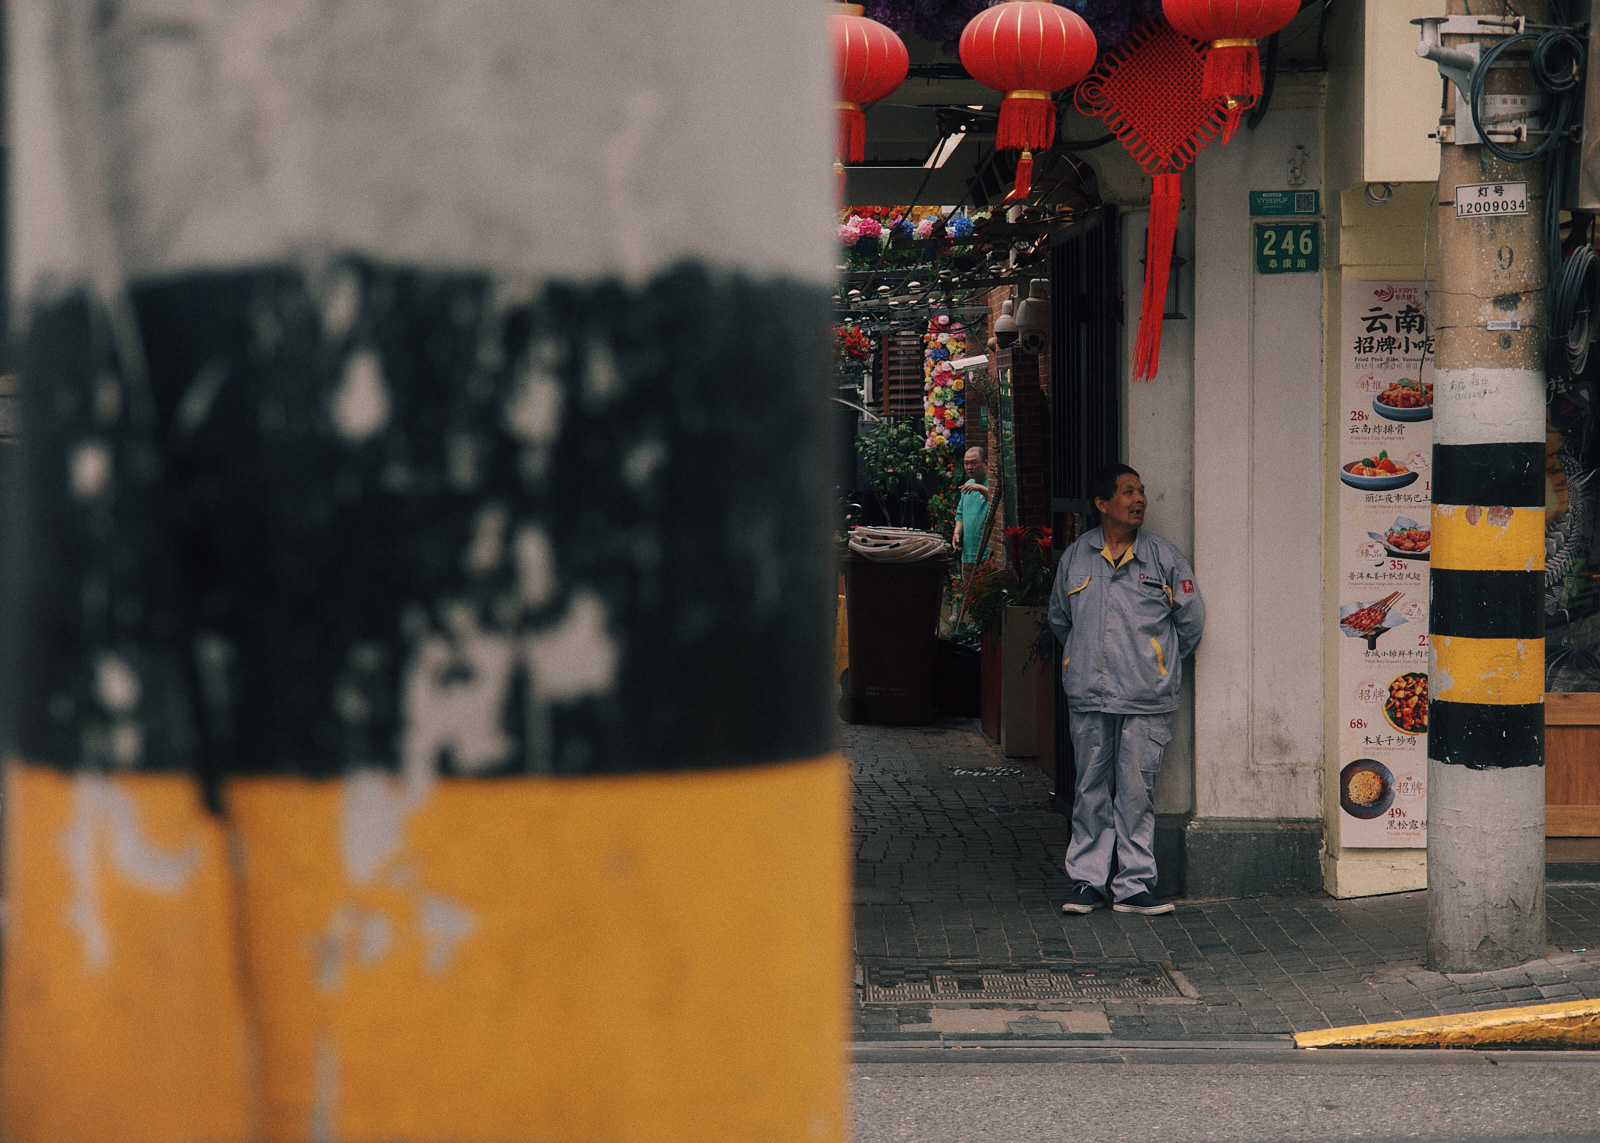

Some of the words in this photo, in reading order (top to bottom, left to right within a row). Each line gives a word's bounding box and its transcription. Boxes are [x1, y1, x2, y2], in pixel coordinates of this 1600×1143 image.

[1477, 186, 1504, 197] 灯号
[1459, 199, 1525, 214] 12009034
[1263, 229, 1313, 255] 246
[1268, 259, 1307, 268] 泰康路
[1360, 304, 1425, 334] 云南
[1353, 335, 1435, 355] 招牌小吃
[1349, 423, 1406, 435] 云南炸排骨
[1358, 688, 1386, 701] 招牌
[1396, 780, 1424, 794] 招牌
